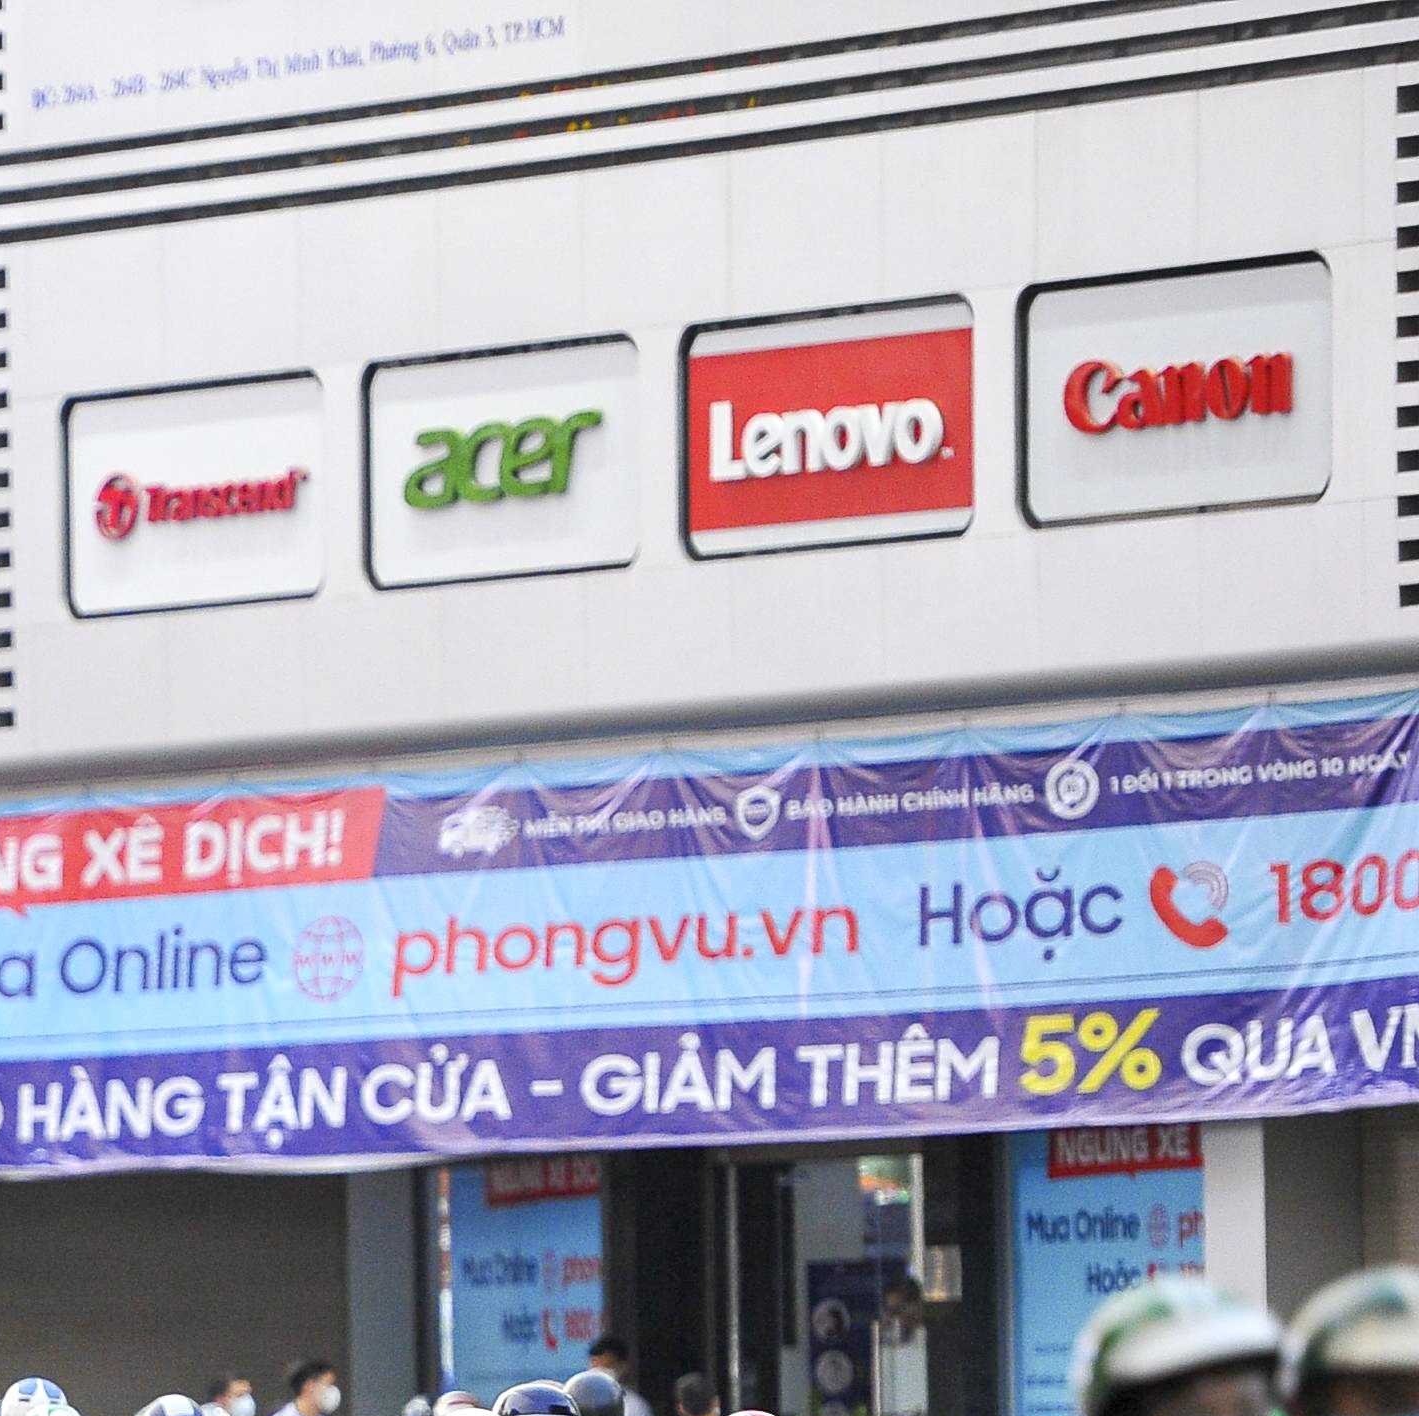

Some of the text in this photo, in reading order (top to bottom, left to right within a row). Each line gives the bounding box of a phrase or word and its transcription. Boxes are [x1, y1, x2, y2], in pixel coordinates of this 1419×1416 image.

[1063, 351, 1294, 437] Canon
[405, 408, 603, 510] acer
[709, 397, 945, 482] Lenovo
[1320, 756, 1345, 778] 10
[81, 812, 163, 887] XÊ
[182, 806, 347, 885] DỊCH!
[60, 924, 268, 994] Online
[389, 906, 860, 999] phongvu.vn
[919, 866, 1124, 963] Hoặc
[15, 1064, 205, 1144] HÀNG
[216, 1053, 348, 1149] TẬN
[362, 1042, 513, 1125] CỬA
[579, 1031, 777, 1116] GIẢM
[795, 1022, 1001, 1108] THÊM
[1018, 1007, 1164, 1096] 5%
[1180, 1015, 1337, 1087] QUA
